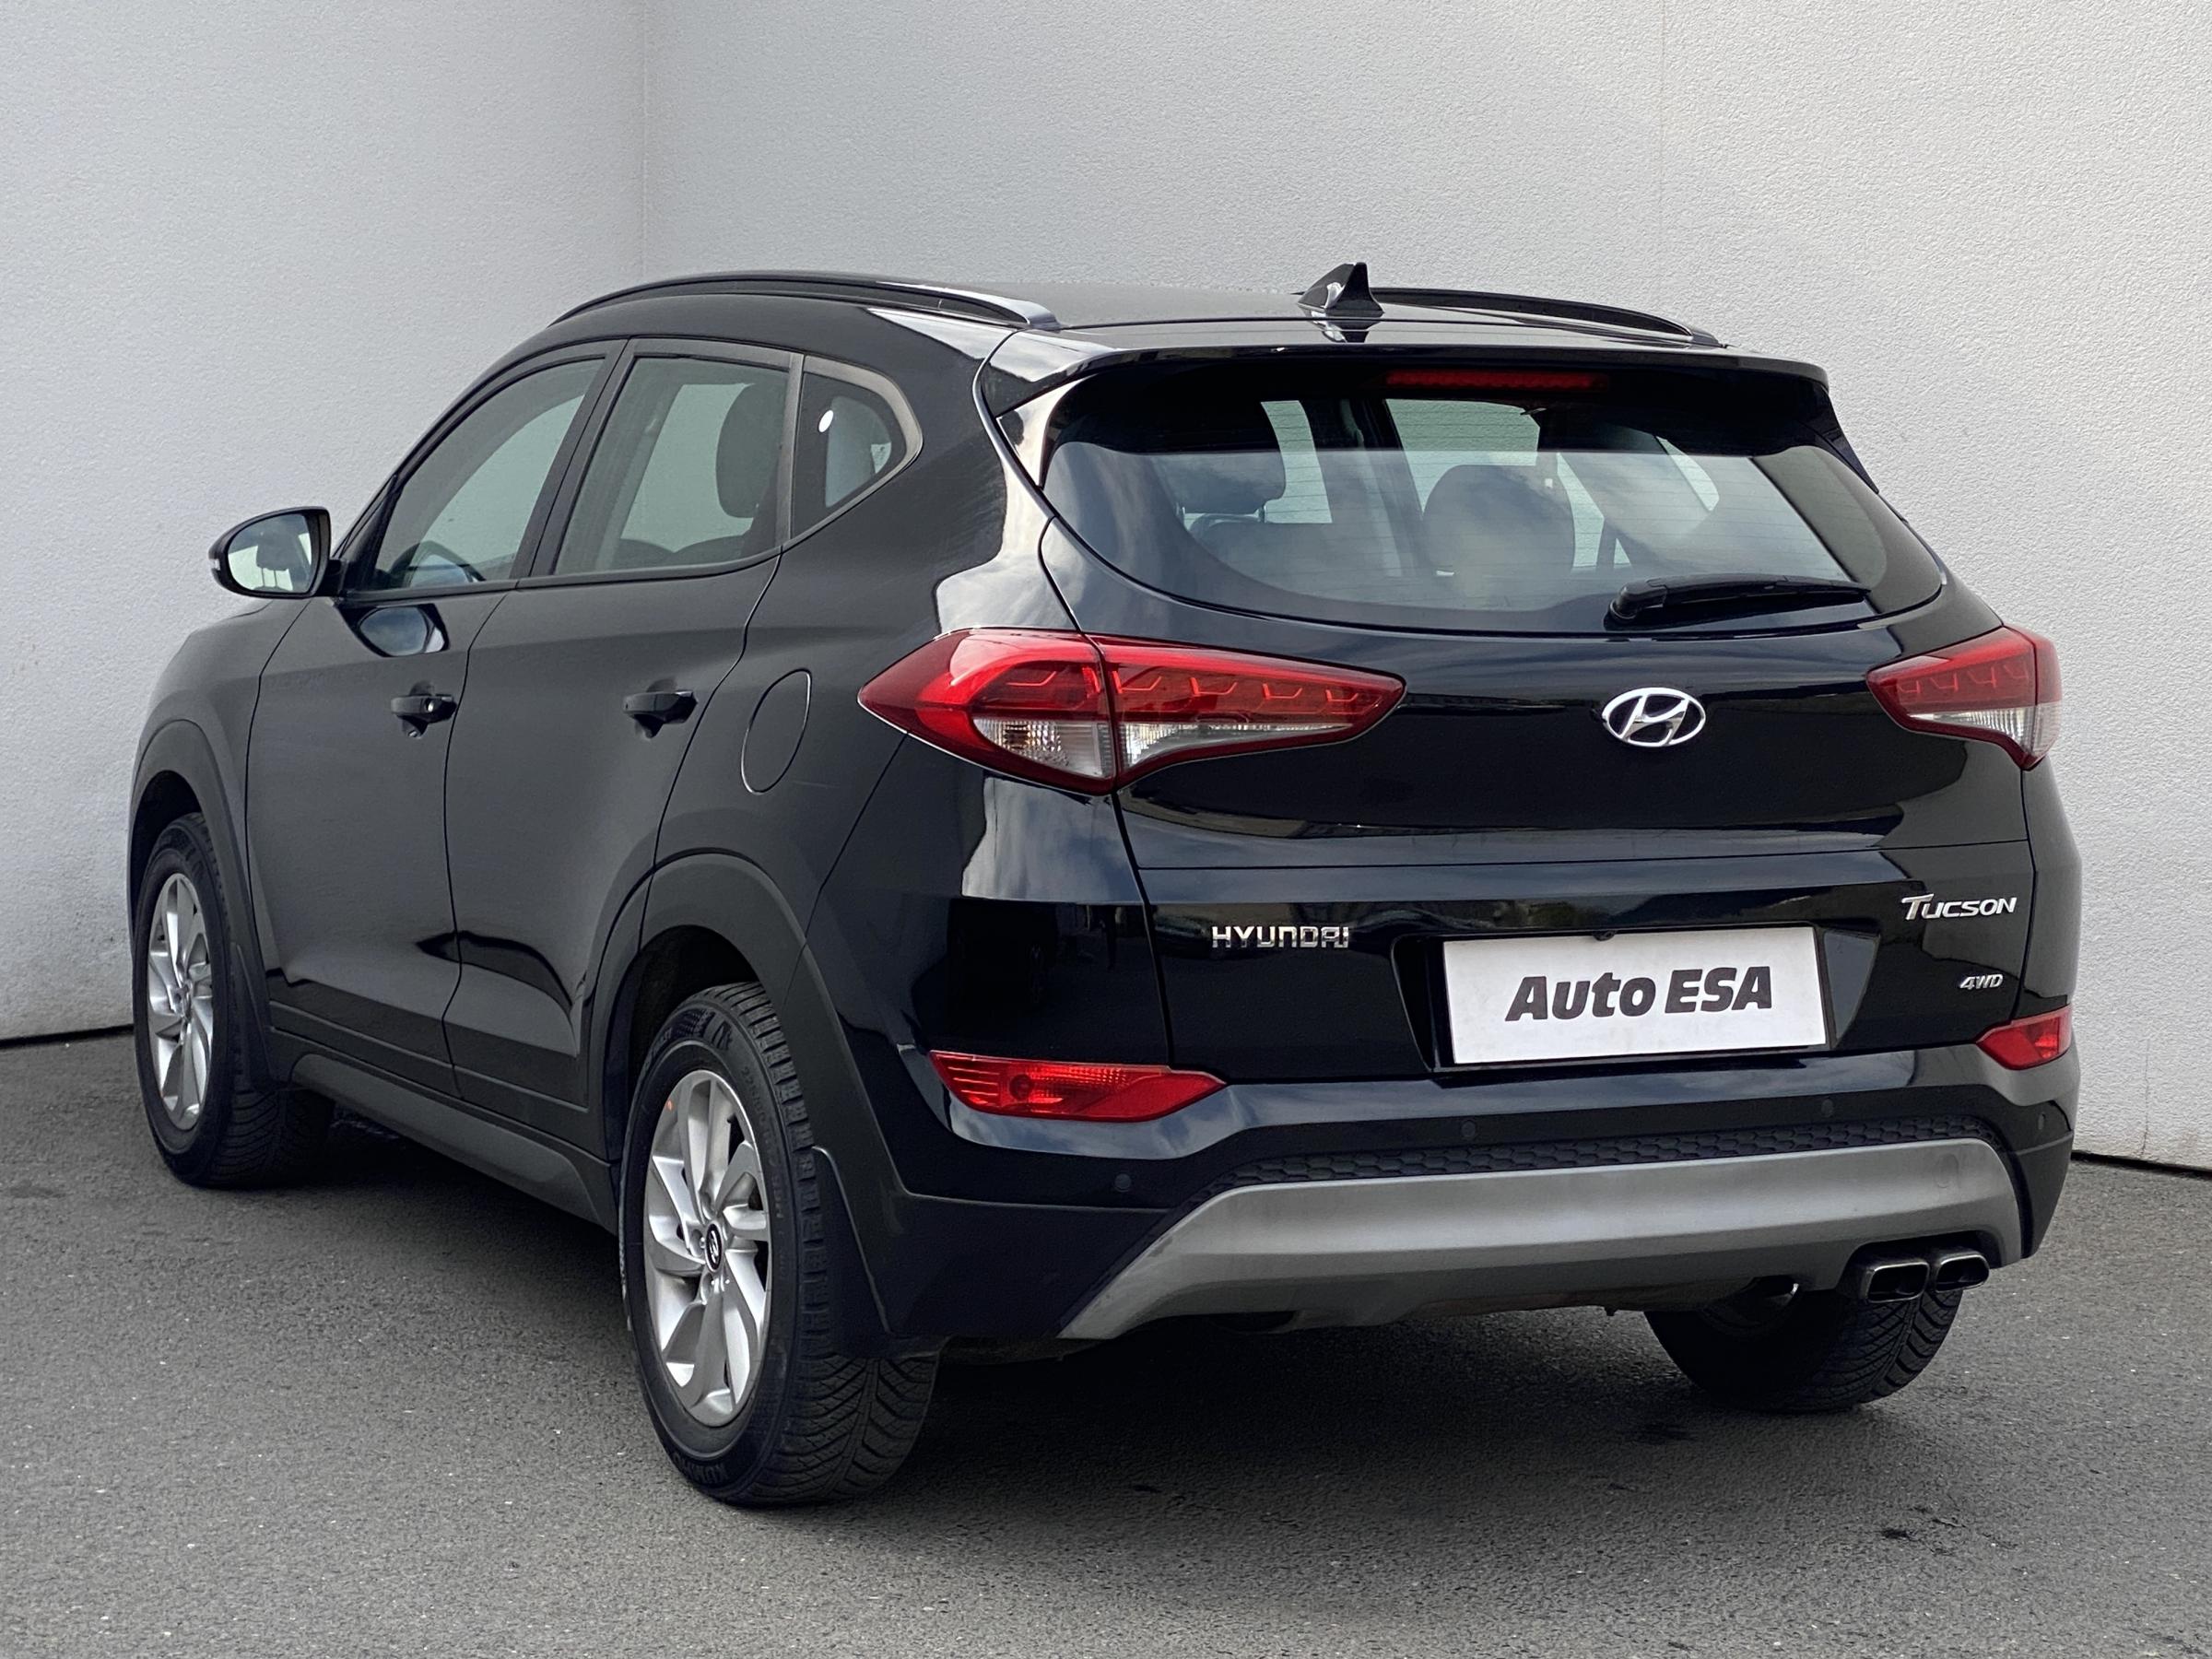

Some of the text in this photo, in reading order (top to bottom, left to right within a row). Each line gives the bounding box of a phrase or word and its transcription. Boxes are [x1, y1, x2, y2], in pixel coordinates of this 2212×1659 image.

[1211, 925, 1349, 948] HYUNDAI
[1504, 965, 1772, 1022] Auto ESA
[1959, 973, 2004, 990] 4WD
[671, 1452, 730, 1485] KUMHO
